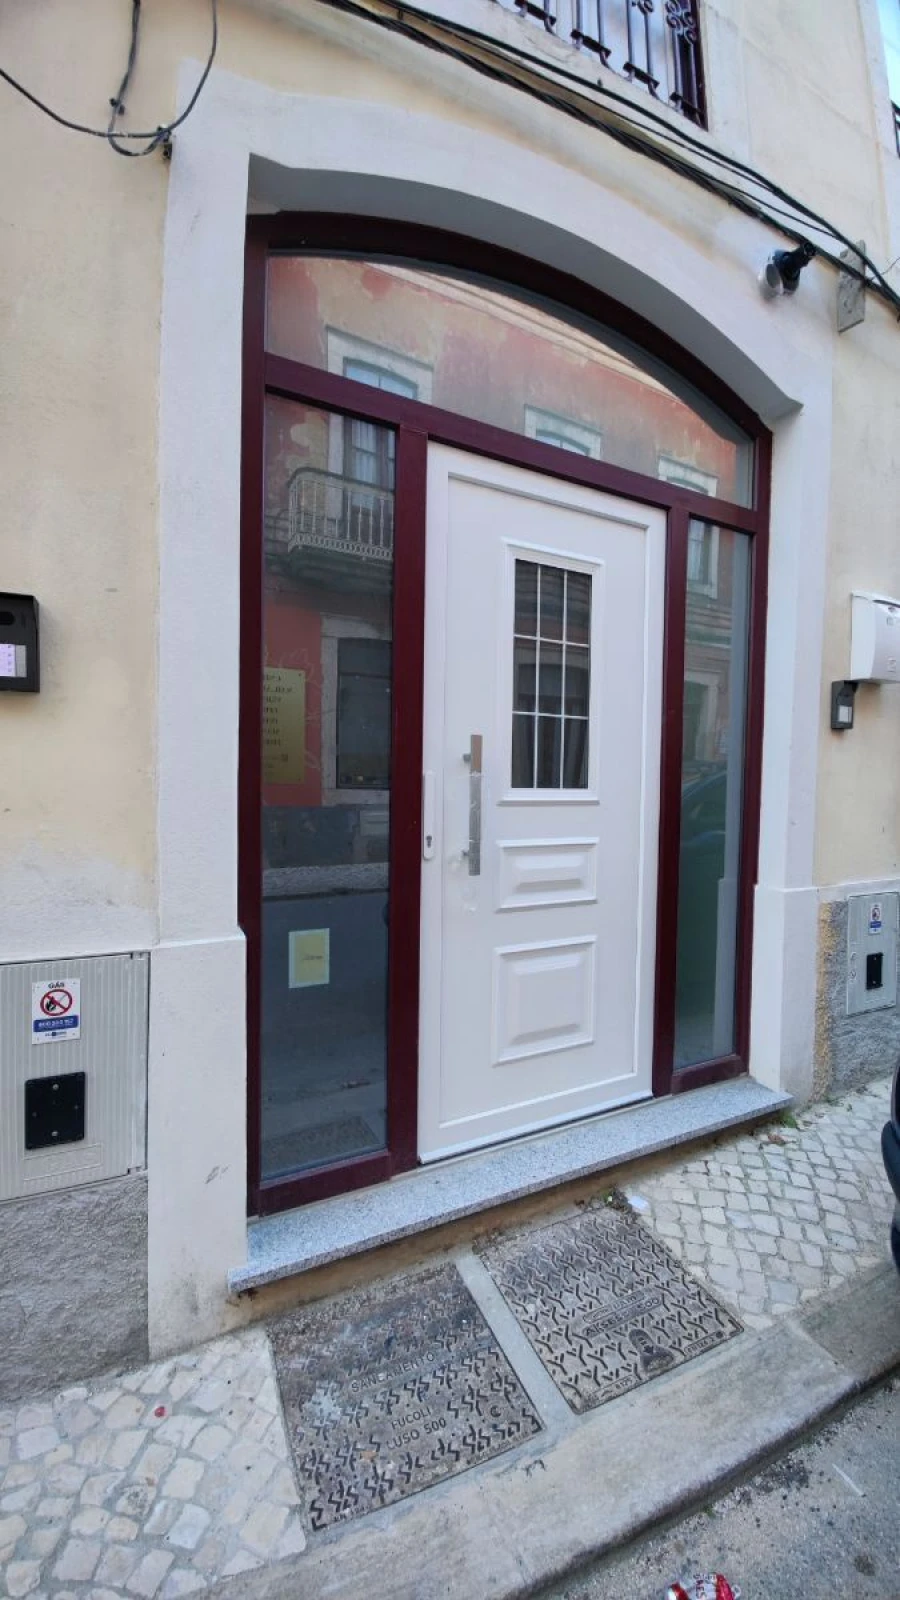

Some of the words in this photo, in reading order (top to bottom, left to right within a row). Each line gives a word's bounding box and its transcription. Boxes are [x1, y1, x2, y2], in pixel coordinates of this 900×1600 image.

[391, 1406, 431, 1430] FUCOLI
[386, 1429, 420, 1450] LUSO
[423, 1417, 446, 1434] 500
